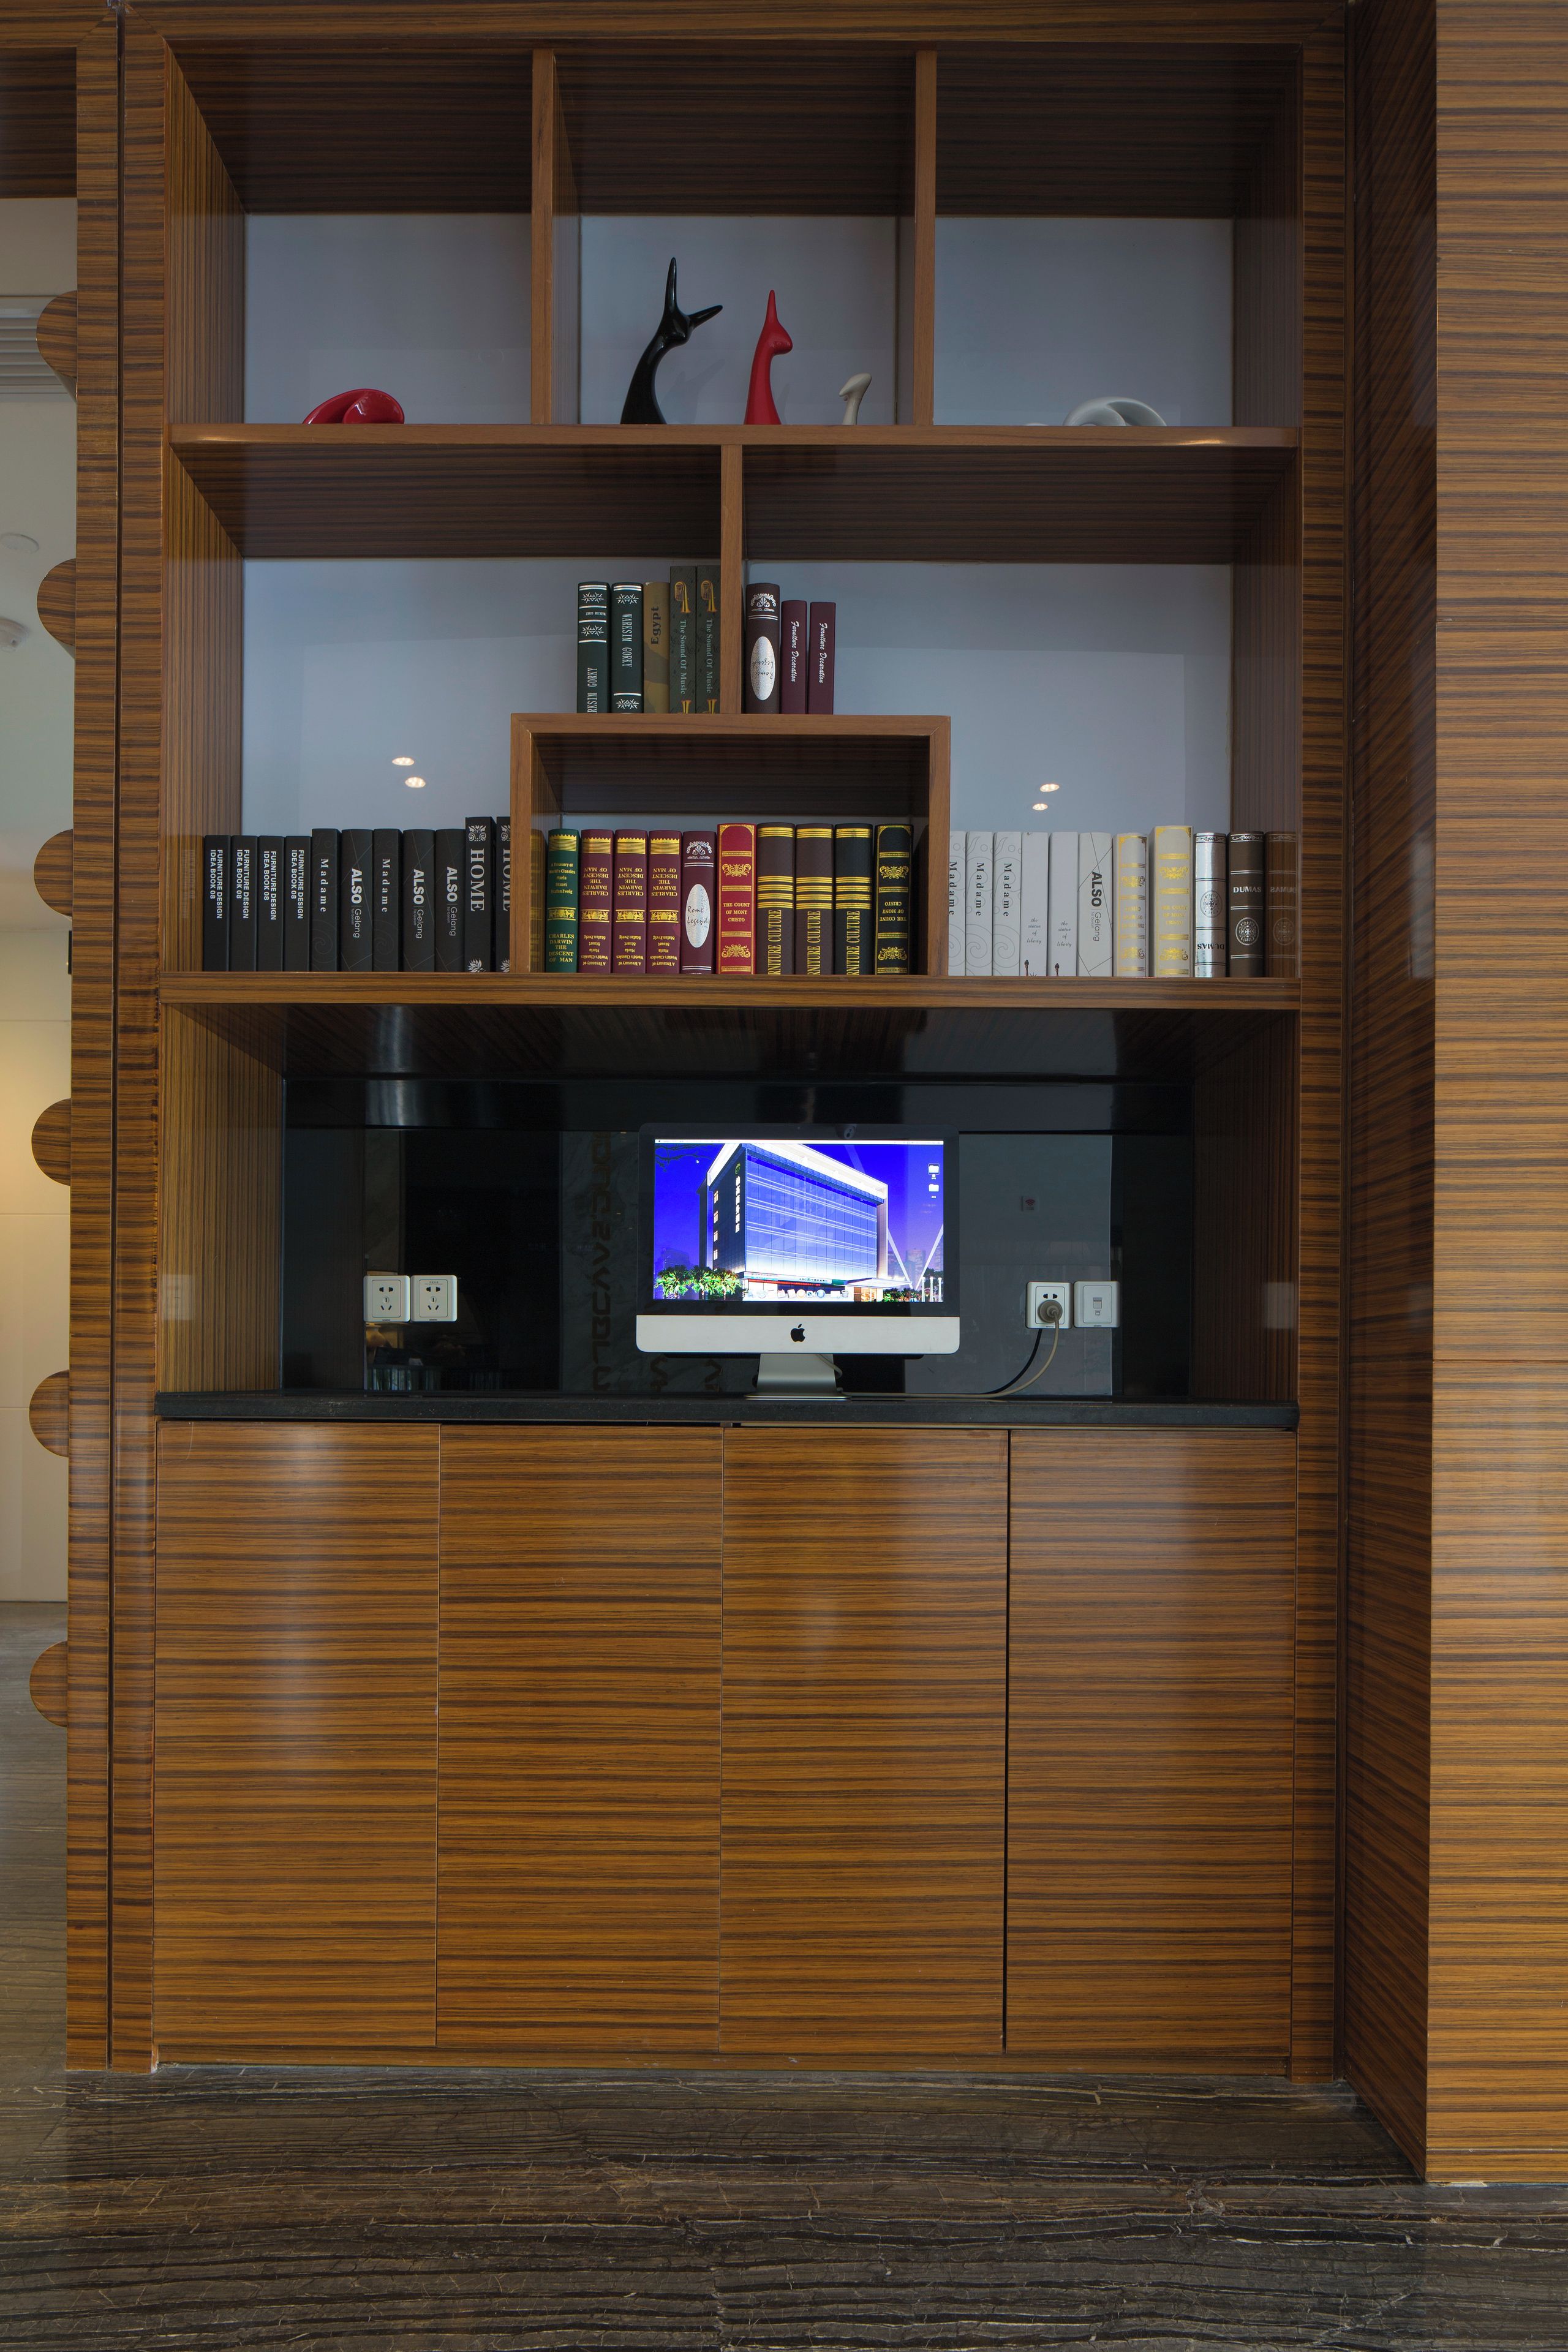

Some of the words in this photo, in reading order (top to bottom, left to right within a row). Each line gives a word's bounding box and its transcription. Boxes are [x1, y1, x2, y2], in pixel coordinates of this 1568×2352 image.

[651, 606, 662, 645] Egypt
[622, 647, 632, 667] GORKY
[680, 659, 687, 669] Of
[706, 658, 713, 668] Of
[587, 668, 598, 687] GORKY
[209, 890, 216, 899] 08
[236, 890, 242, 899] 08
[263, 892, 270, 900] 08
[291, 891, 296, 899] 08
[320, 859, 329, 912] Madame
[351, 868, 362, 904] ALSO
[382, 859, 391, 912] Madame
[413, 869, 424, 905] ALSO
[447, 867, 458, 902] ALSO
[470, 848, 484, 912] HOME
[976, 862, 984, 916] Madame
[1003, 863, 1012, 917] Madame
[1091, 872, 1102, 907] ALSO
[353, 908, 362, 938] Gelang
[415, 909, 424, 939] Gelang
[449, 907, 458, 936] Gelang
[768, 910, 782, 942] CULTURE
[807, 911, 821, 943] CULTURE
[846, 911, 860, 943] CULTURE
[1093, 912, 1102, 941] Gelang
